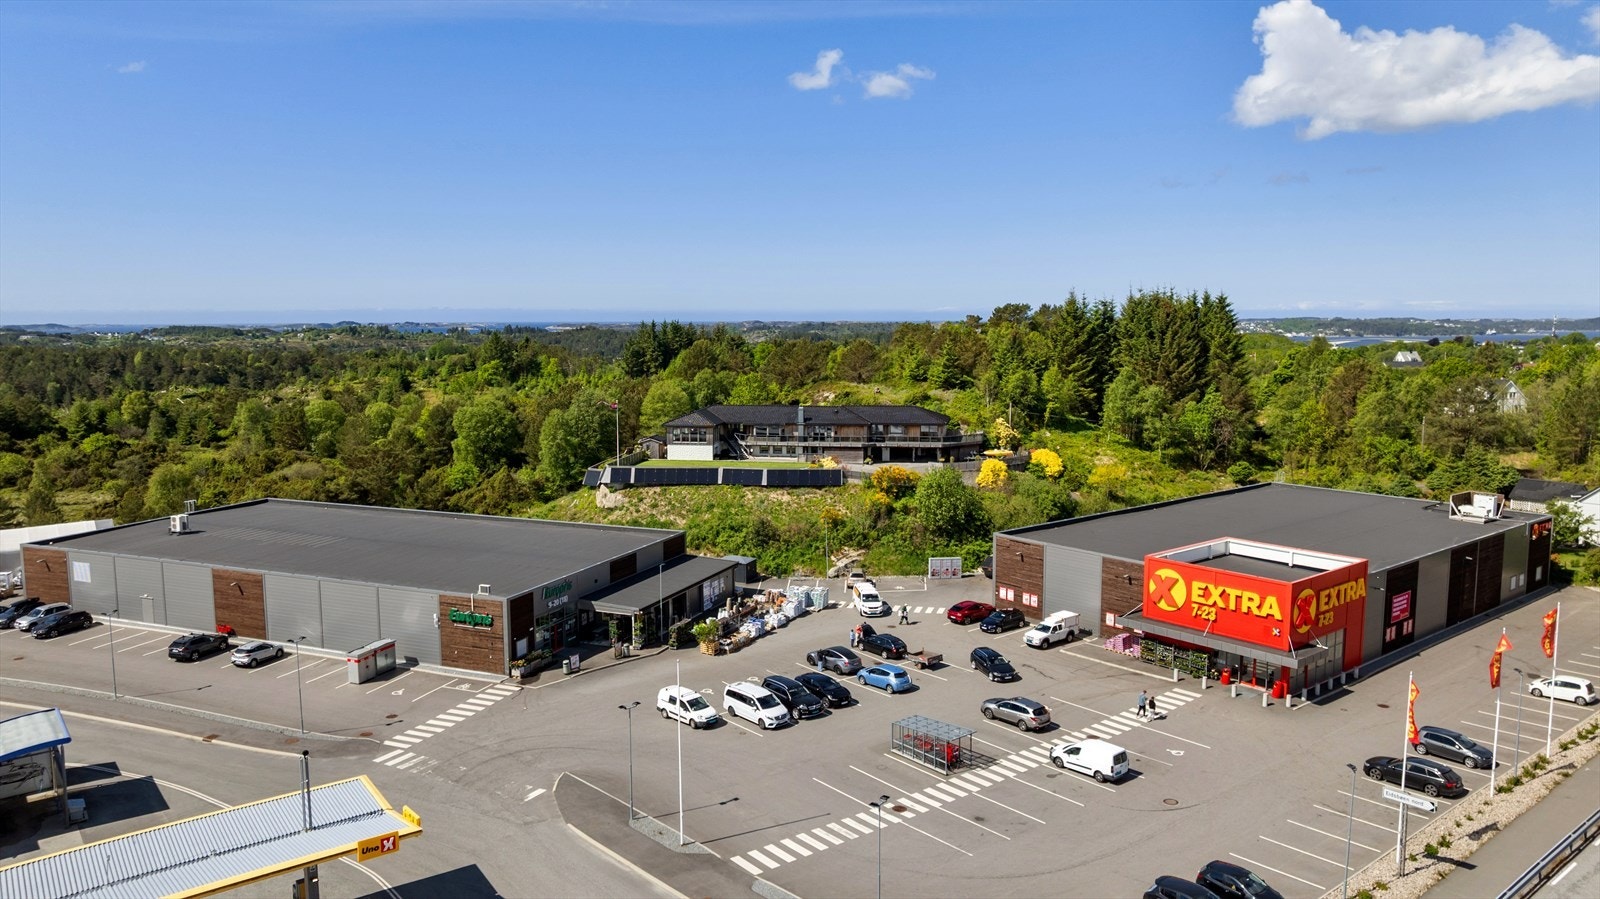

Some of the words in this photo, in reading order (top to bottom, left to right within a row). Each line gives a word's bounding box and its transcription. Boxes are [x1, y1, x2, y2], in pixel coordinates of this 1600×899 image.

[1191, 581, 1283, 621] EXTRA
[1318, 577, 1366, 612] EXTRA
[1191, 603, 1217, 621] 7-23
[1318, 611, 1334, 628] 7-23
[1412, 799, 1424, 807] nord
[362, 845, 380, 855] Uno
